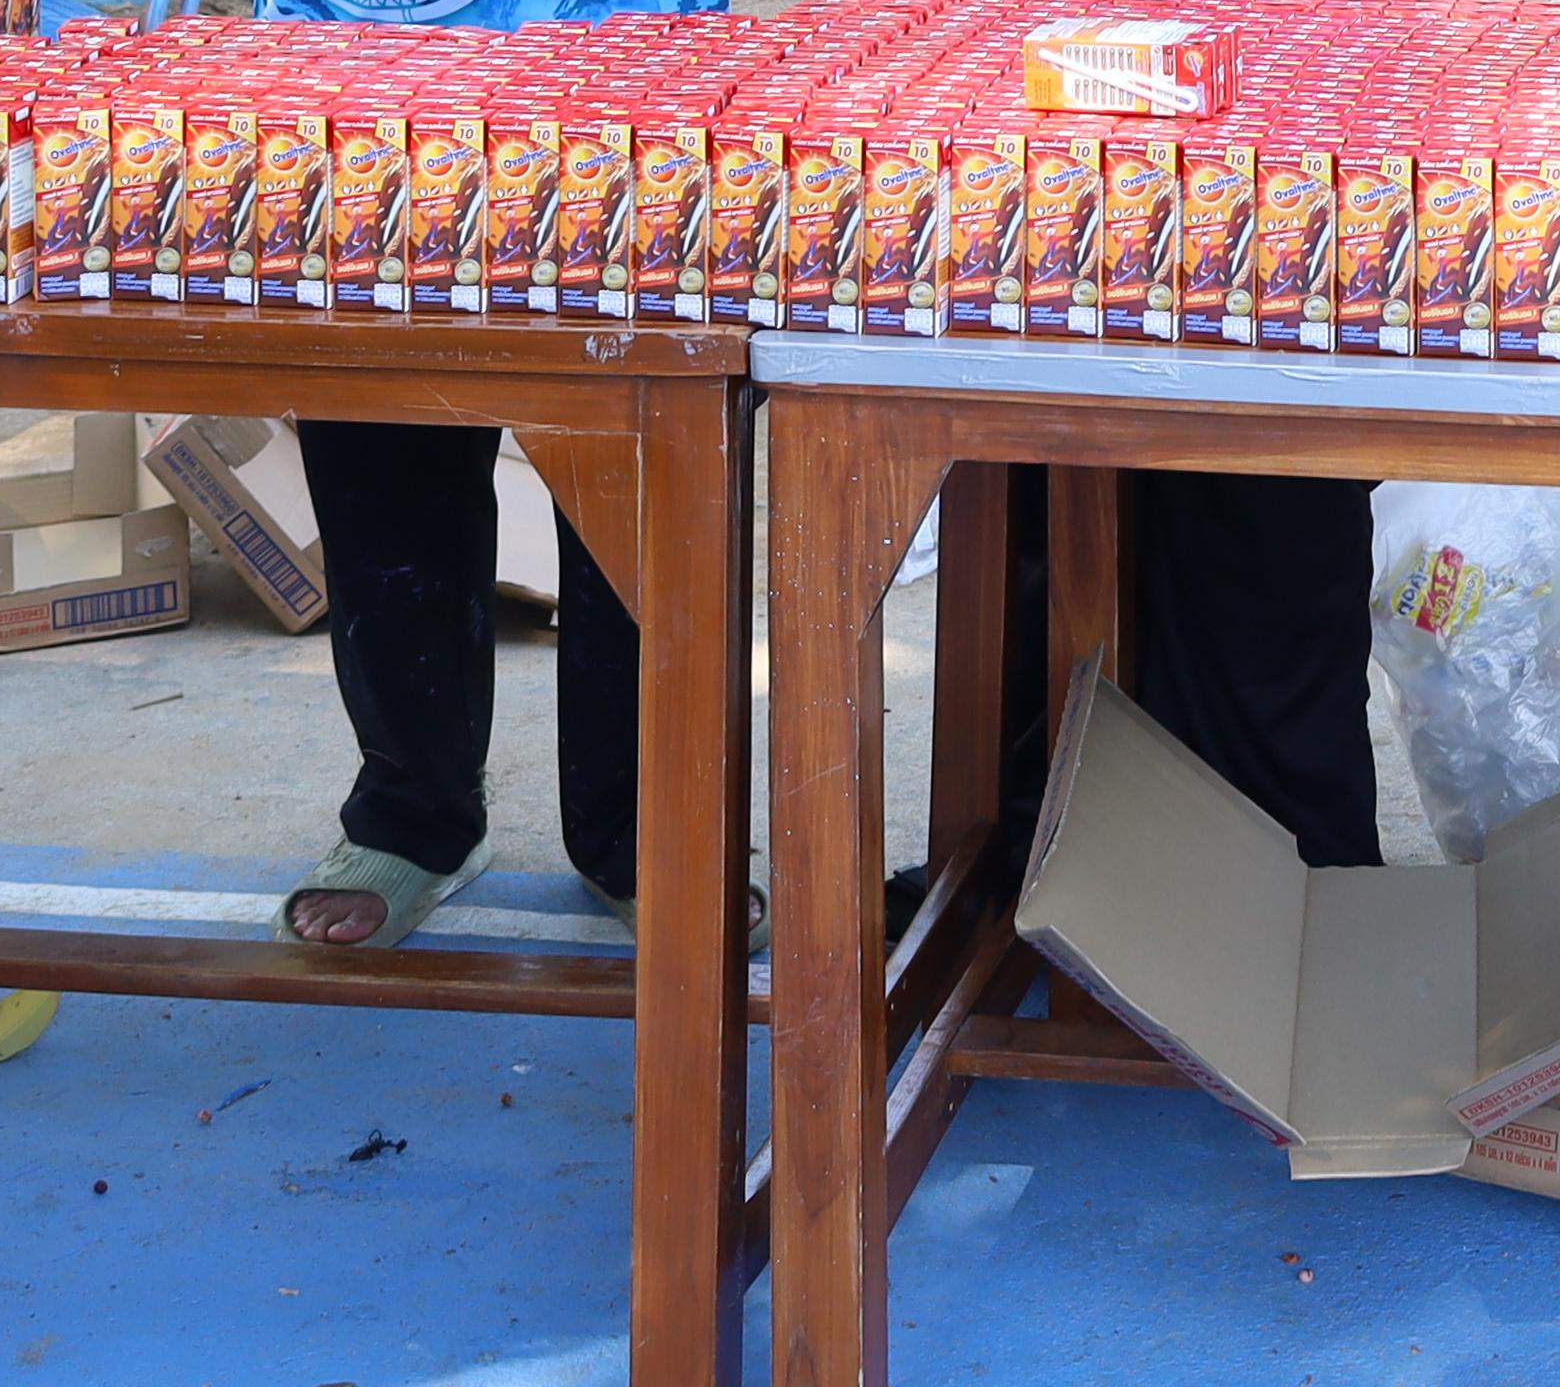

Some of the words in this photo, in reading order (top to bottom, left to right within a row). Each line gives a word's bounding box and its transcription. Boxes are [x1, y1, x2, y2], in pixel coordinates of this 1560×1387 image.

[84, 119, 99, 129] 10
[161, 118, 174, 129] 10
[235, 120, 249, 131] 10
[303, 124, 317, 135] 10
[382, 126, 396, 138] 10
[459, 128, 474, 139] 10
[536, 129, 550, 140] 10
[606, 131, 620, 143] 10
[129, 138, 168, 156] Ovaltine
[681, 135, 695, 146] 10
[759, 140, 773, 151] 10
[1000, 142, 1014, 154] 10
[50, 139, 93, 159] Ovaltine
[202, 139, 242, 159] Ovaltine
[272, 143, 312, 163] Ovaltine
[351, 145, 392, 165] Ovaltine
[837, 145, 852, 157] 10
[914, 147, 928, 159] 10
[1075, 146, 1090, 158] 10
[1151, 148, 1166, 160] 10
[426, 148, 469, 167] Ovaltine
[504, 148, 546, 168] Ovaltine
[575, 151, 617, 171] Ovaltine
[651, 154, 694, 175] Ovaltine
[1230, 152, 1245, 165] 10
[728, 158, 769, 178] Ovaltine
[967, 163, 1011, 182] Ovaltine
[1306, 160, 1321, 173] 10
[1386, 163, 1402, 175] 10
[1466, 165, 1481, 177] 10
[805, 164, 847, 185] Ovaltine
[881, 166, 925, 187] Ovaltine
[1043, 166, 1086, 185] Ovaltine
[1121, 168, 1163, 188] Ovaltine
[1545, 168, 1560, 181] 10
[1198, 174, 1238, 194] Ovaltine
[1274, 179, 1317, 201] Ovaltine
[1354, 184, 1397, 204] Ovaltine
[1434, 187, 1476, 207] Ovaltine
[1512, 189, 1555, 210] Ovaltine
